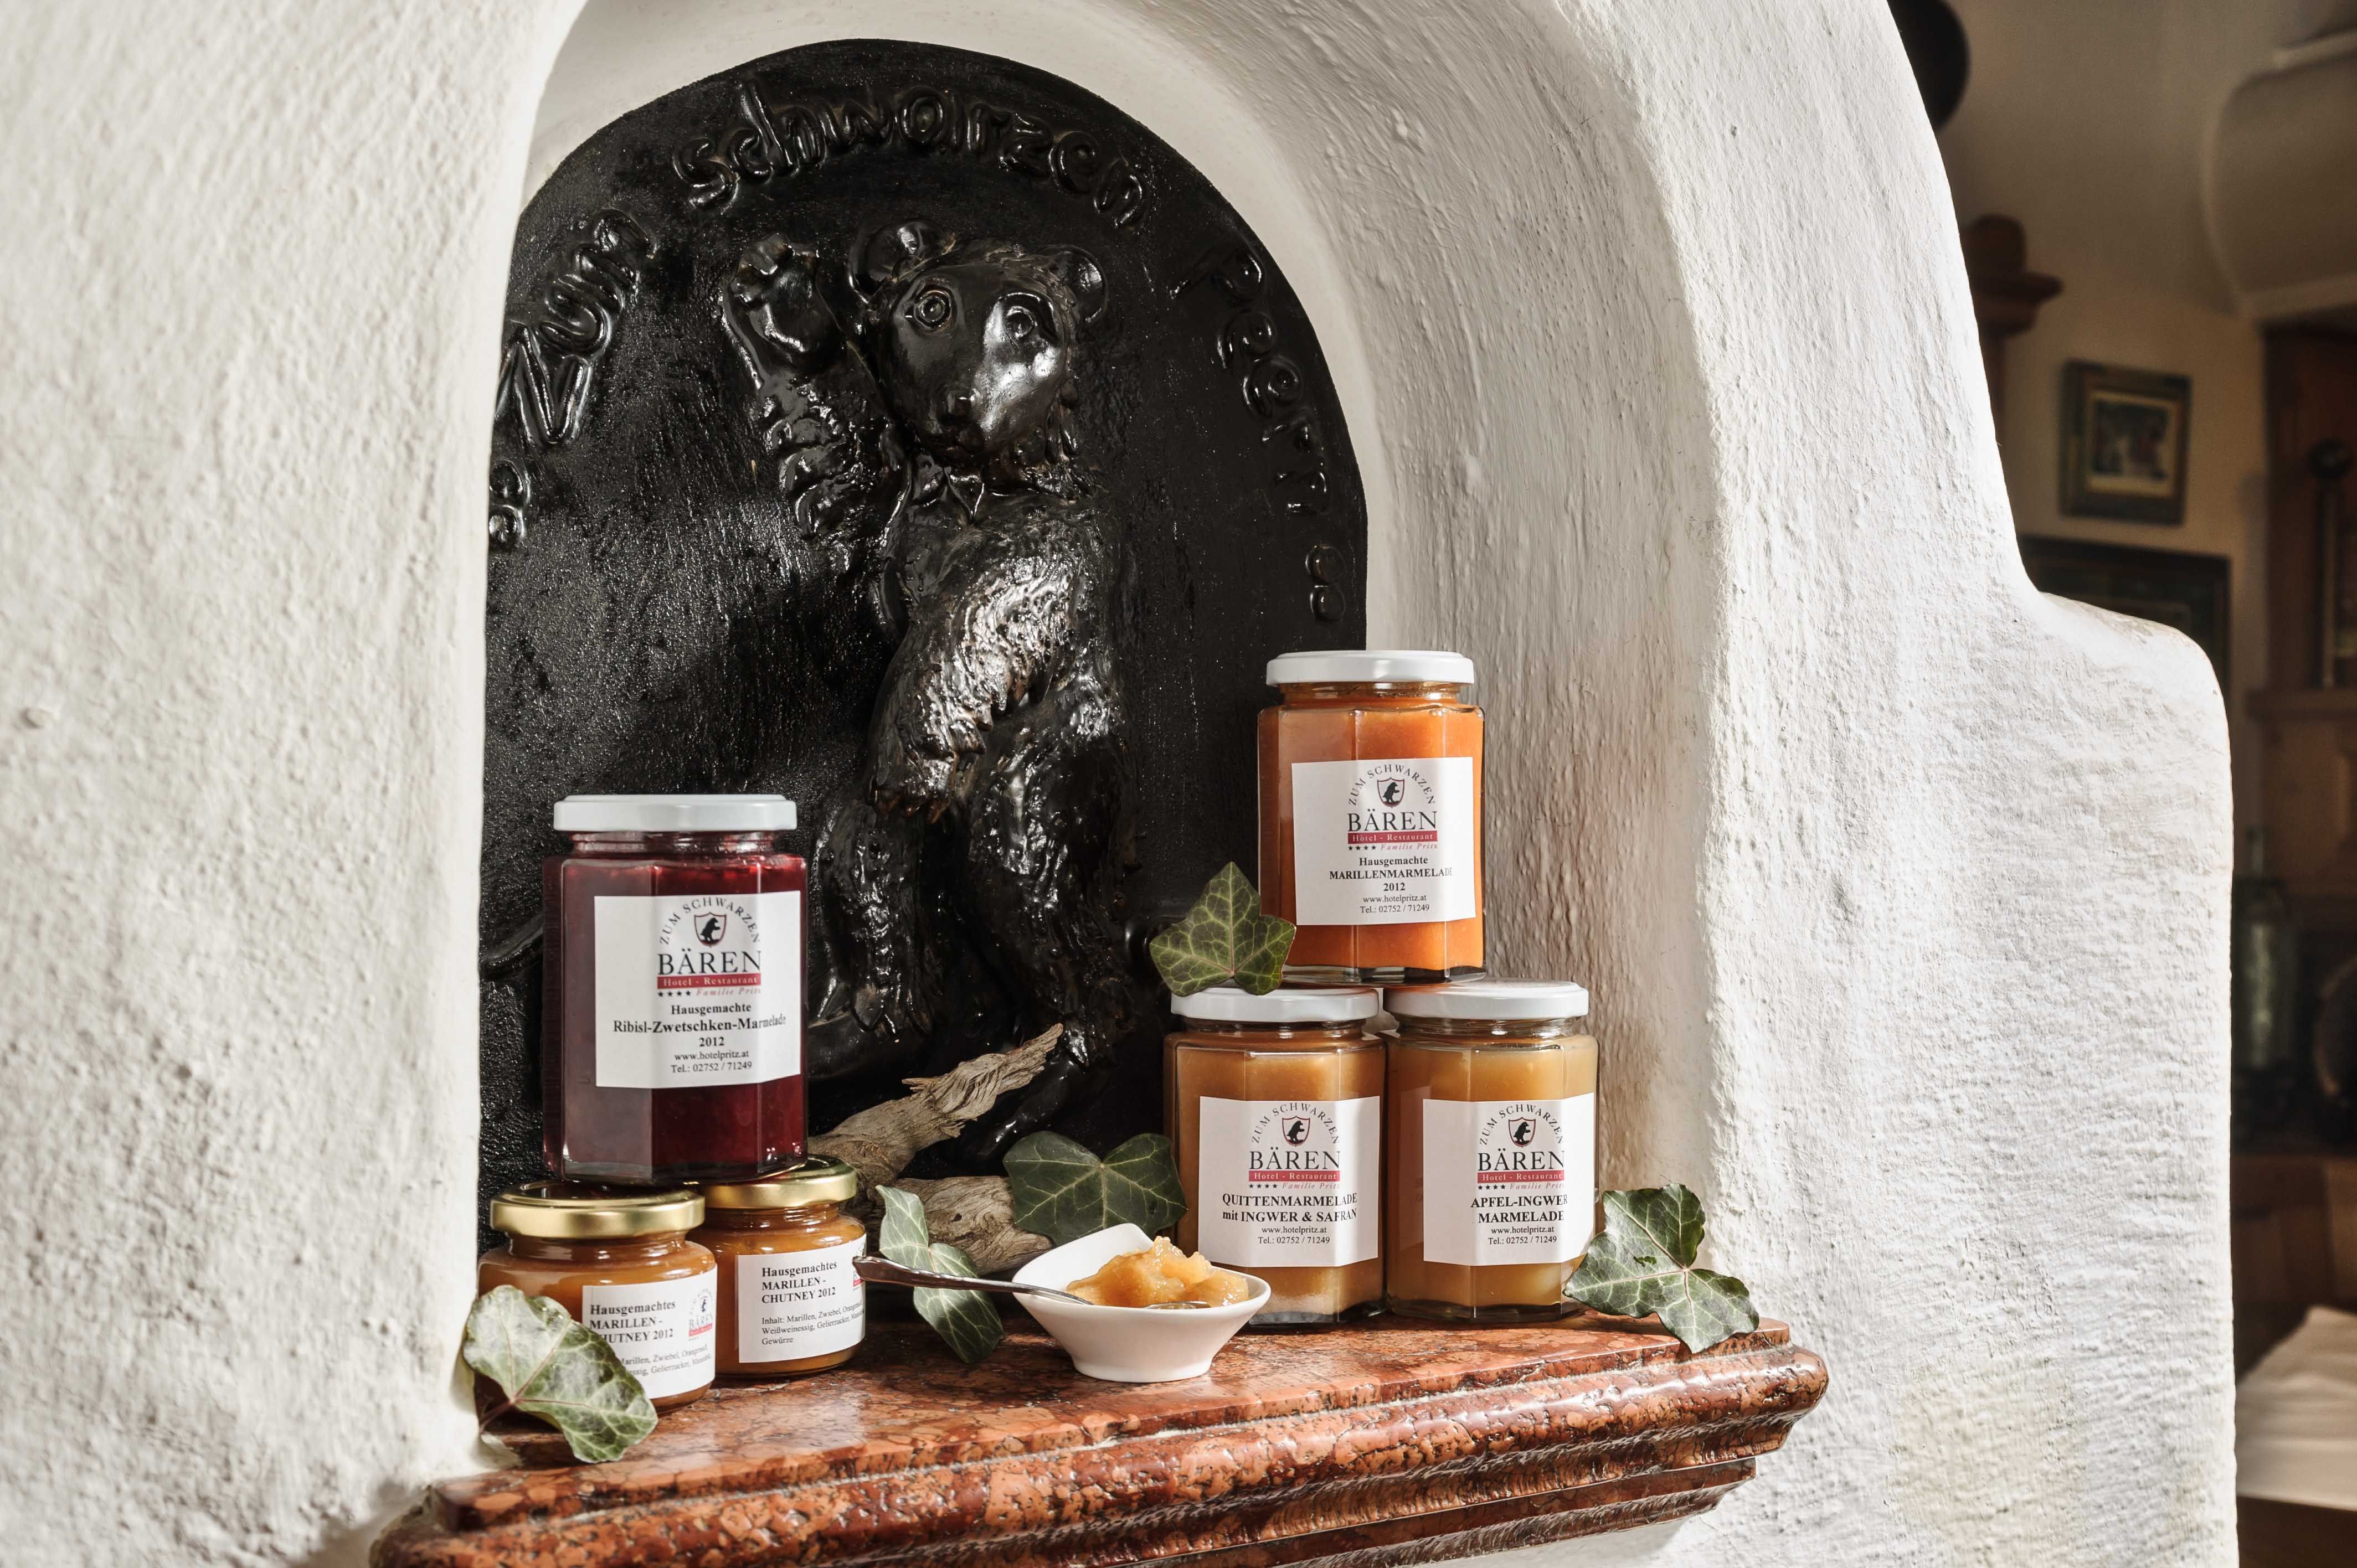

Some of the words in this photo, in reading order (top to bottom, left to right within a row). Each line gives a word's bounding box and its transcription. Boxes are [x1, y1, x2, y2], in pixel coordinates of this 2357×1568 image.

[1349, 778, 1366, 806] ZUM
[1367, 764, 1435, 804] SCHWARZEN
[1347, 808, 1437, 832] BÄREN
[1359, 857, 1428, 867] Hausgemachte
[1329, 868, 1453, 880] MARILLENMARMELADE
[1383, 883, 1405, 891] 2012
[1363, 895, 1427, 903] www.hotelpritz.at
[660, 913, 681, 945] ZUM
[682, 897, 760, 943] SCHWARZEN
[657, 948, 761, 975] BÄREN
[704, 977, 758, 986] Restaurant
[671, 1003, 752, 1016] Hausgemachte
[613, 1013, 786, 1033] Ribisl-Zwetschken-Marmelade
[699, 1037, 724, 1047] 2012
[675, 1051, 749, 1061] www.hotelpritz.at
[671, 1065, 690, 1073] Tel.:
[693, 1063, 719, 1072] 02752
[727, 1061, 752, 1070] 71249
[1252, 1116, 1270, 1143] ZUM
[1273, 1102, 1339, 1144] SCHWARZEN
[1480, 1118, 1497, 1145] ZUM
[1499, 1104, 1563, 1144] SCHWARZEN
[1249, 1147, 1341, 1169] BÄREN
[1478, 1148, 1564, 1171] BÄREN
[1223, 1193, 1357, 1206] QUITTENMARMELADE
[1471, 1194, 1567, 1208] APFEL-INGWER
[1223, 1210, 1238, 1220] mit
[1241, 1211, 1298, 1222] INGWER
[1302, 1212, 1312, 1222] &
[1316, 1208, 1356, 1222] SAFRAN
[1478, 1211, 1564, 1223] MARMELADE
[1262, 1226, 1327, 1235] www.hotelpritz.at
[1491, 1225, 1554, 1234] www.hotelpritz.at
[762, 1262, 837, 1277] Hausgemachtes
[762, 1277, 820, 1290] MARILLEN
[762, 1291, 816, 1303] CHUTNEY
[819, 1287, 836, 1297] 2012
[590, 1301, 675, 1316] Hausgemachtes
[819, 1308, 841, 1318] Zwiebel,
[590, 1317, 657, 1329] MARILLEN
[762, 1324, 815, 1335] Weißweinessig,
[653, 1328, 673, 1340] 2012
